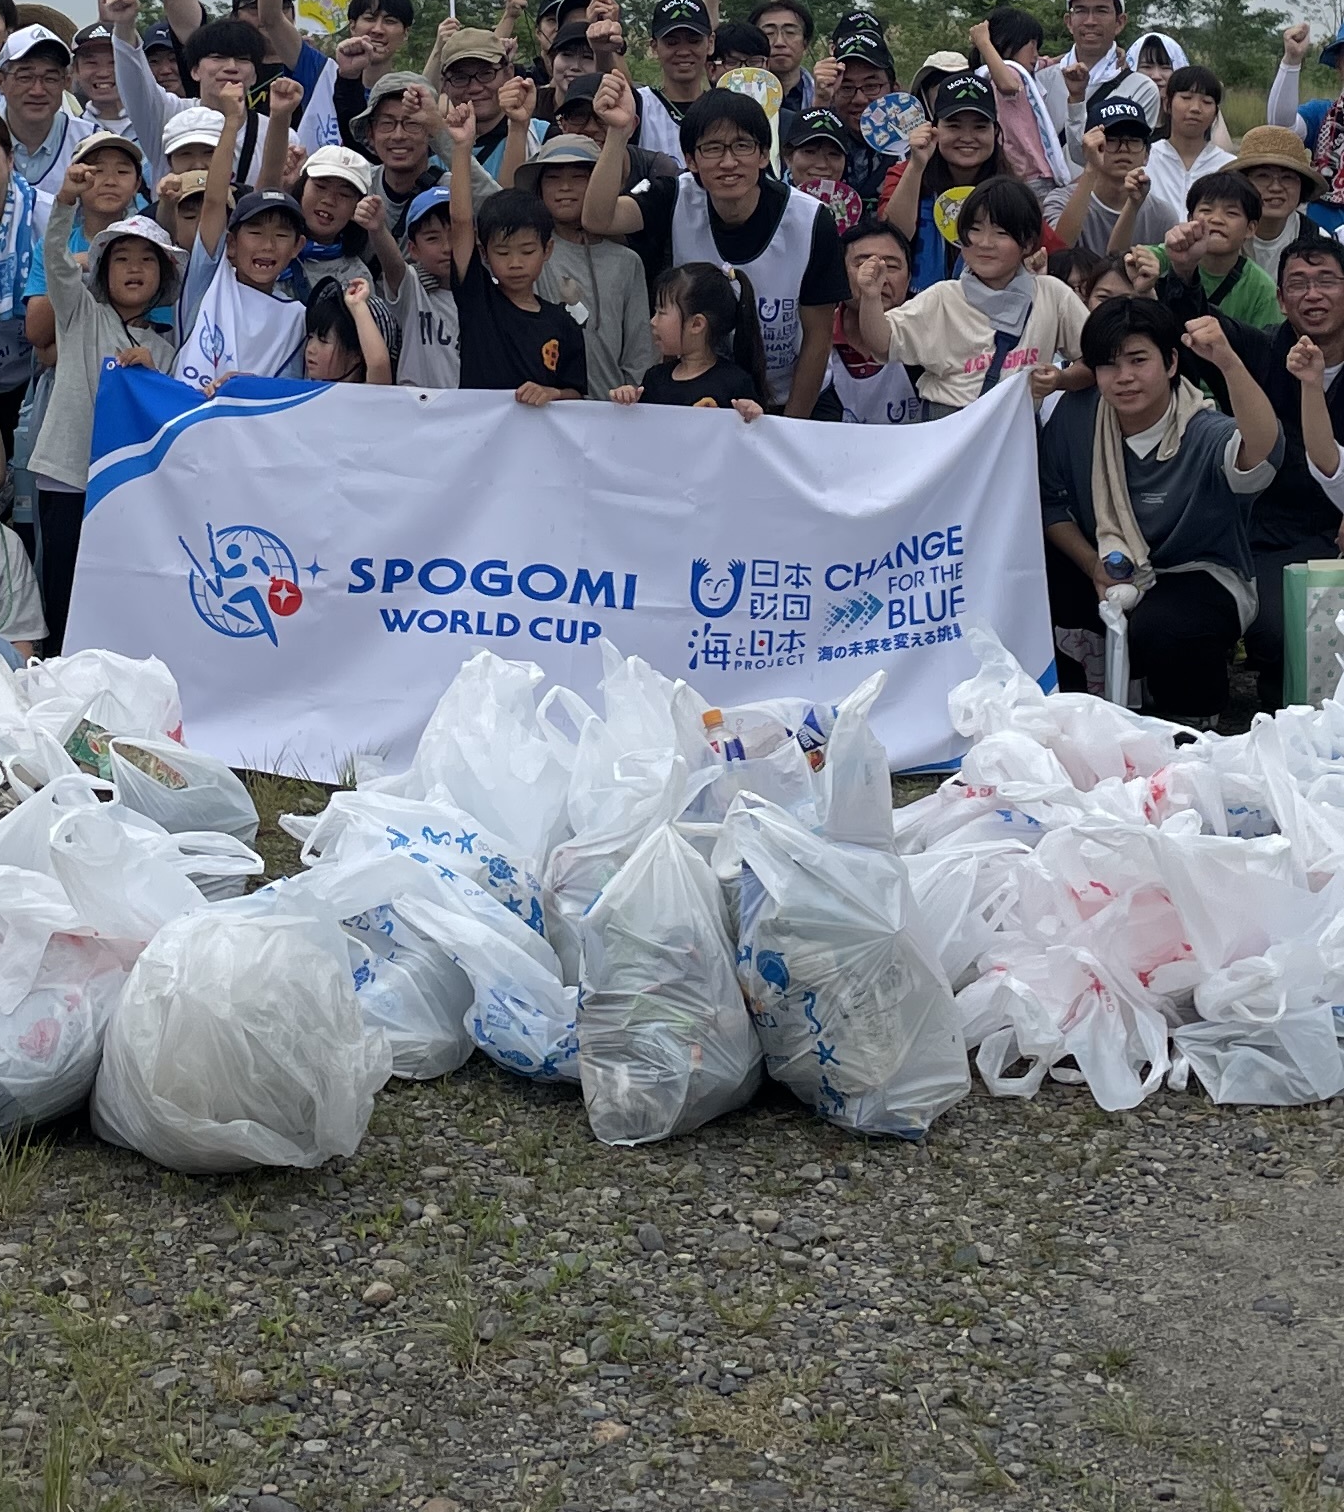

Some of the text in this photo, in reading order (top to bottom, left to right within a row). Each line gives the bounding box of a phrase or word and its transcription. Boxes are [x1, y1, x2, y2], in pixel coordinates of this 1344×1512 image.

[1099, 104, 1139, 120] TOKYO
[750, 559, 812, 590] 日本
[824, 524, 964, 592] CHANGE
[347, 557, 638, 610] SPOGOMI
[887, 561, 964, 595] FOR THE
[749, 592, 811, 621] 財団
[887, 584, 967, 630] BLUE
[379, 608, 602, 645] WORLD CUP
[687, 622, 806, 671] 海と日本
[734, 653, 805, 671] PROJECT
